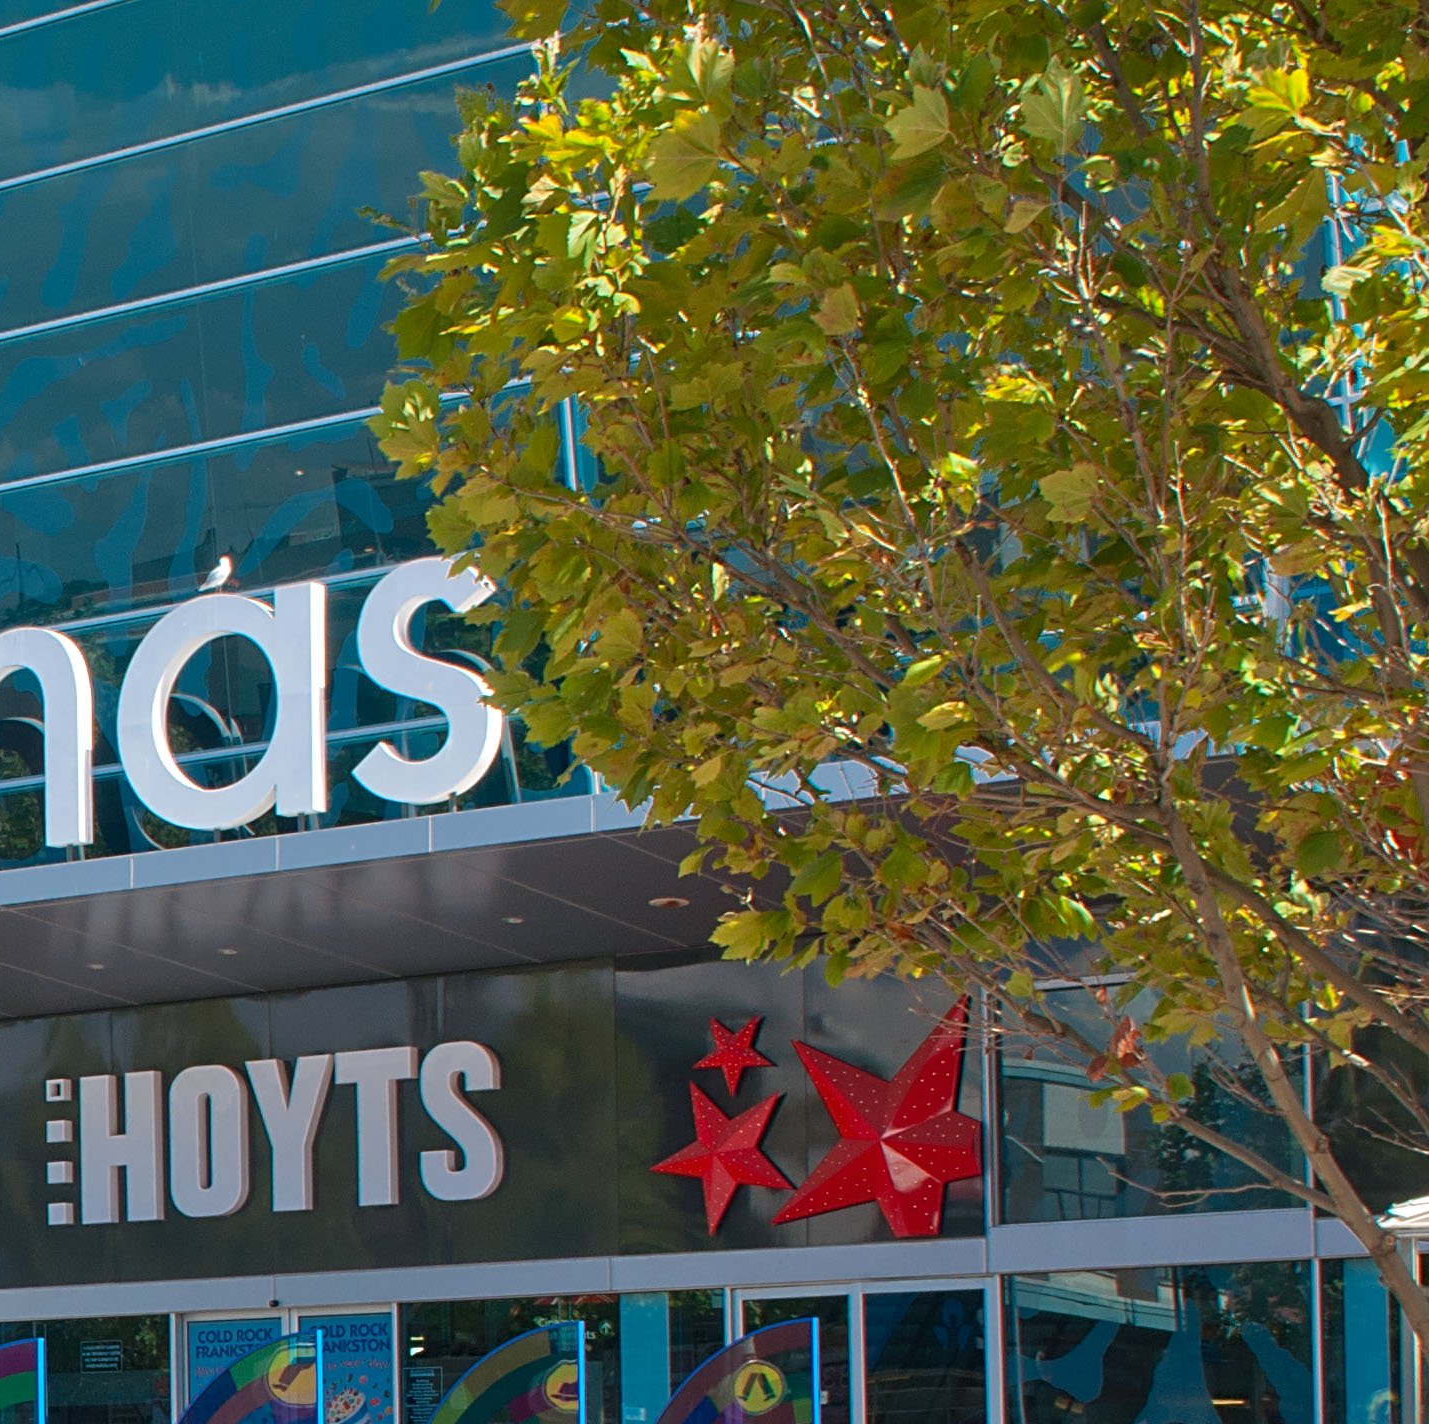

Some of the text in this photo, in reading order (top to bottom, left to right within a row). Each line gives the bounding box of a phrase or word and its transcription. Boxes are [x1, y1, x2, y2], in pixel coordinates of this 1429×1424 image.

[80, 1040, 504, 1225] HOYTS
[197, 1327, 273, 1344] COLD ROCK
[349, 1322, 389, 1337] ROCK
[322, 1338, 391, 1353] ANKSTON
